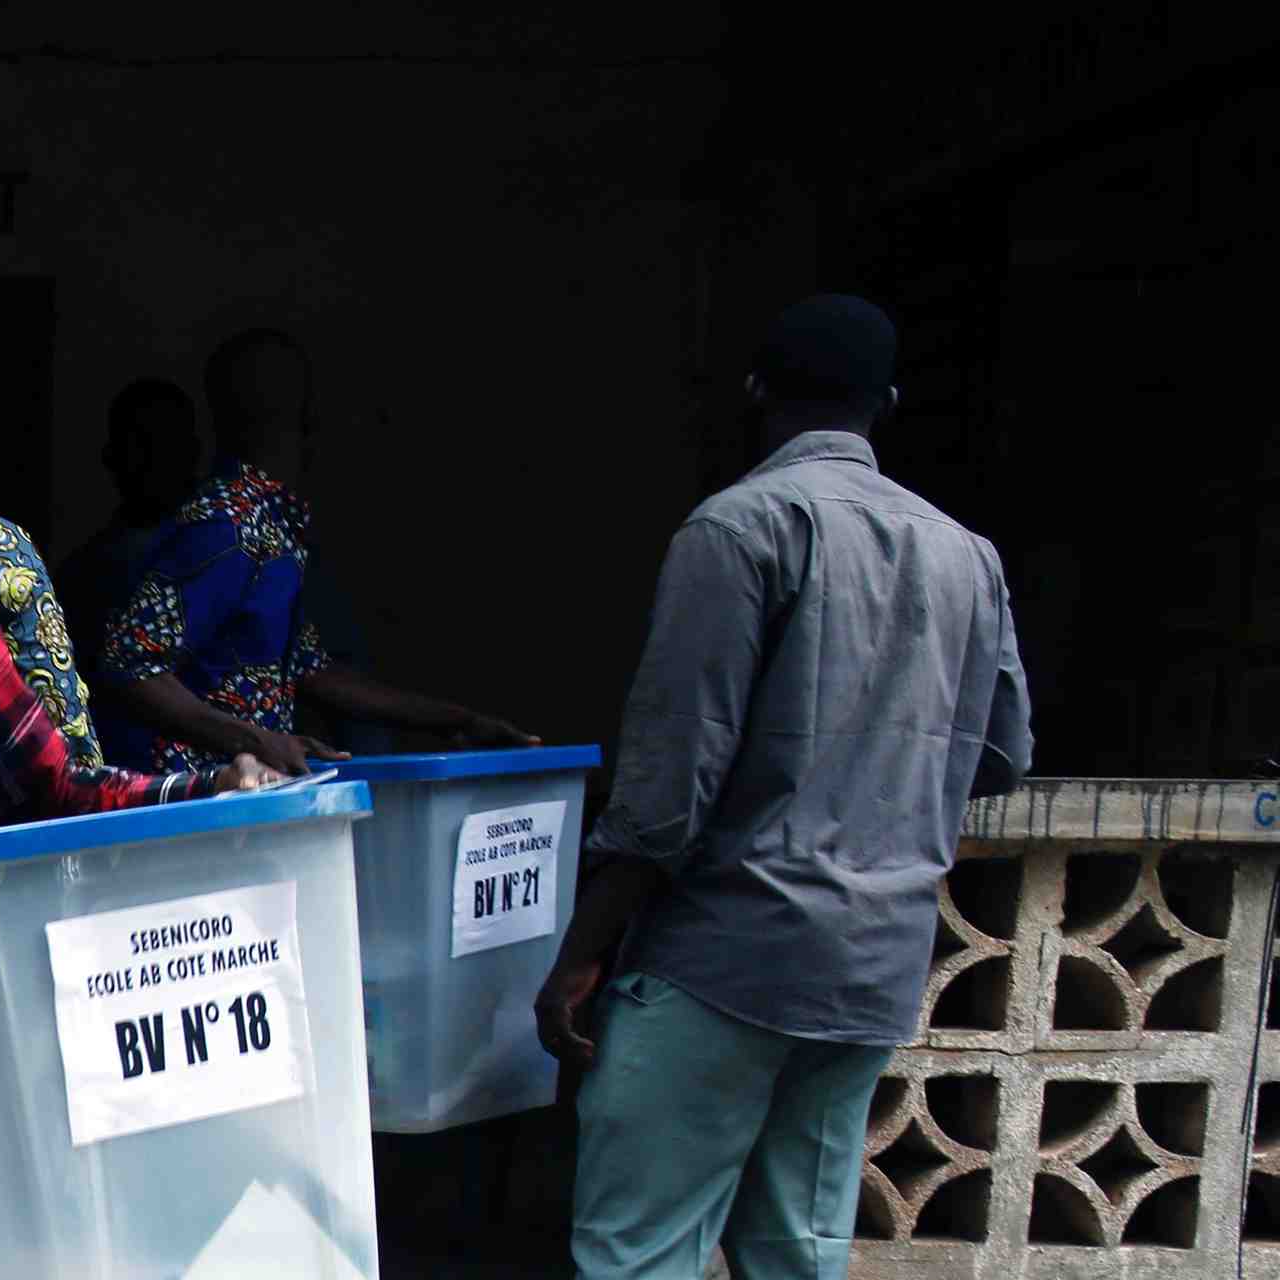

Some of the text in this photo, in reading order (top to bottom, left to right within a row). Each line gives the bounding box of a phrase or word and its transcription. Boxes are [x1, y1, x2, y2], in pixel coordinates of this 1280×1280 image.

[474, 876, 496, 919] BV
[522, 866, 540, 907] 21
[130, 915, 233, 955] SEBENICORO
[87, 940, 280, 998] ECOLE AB COTE MARCHE
[115, 1013, 166, 1080] BV
[228, 991, 272, 1054] 18
